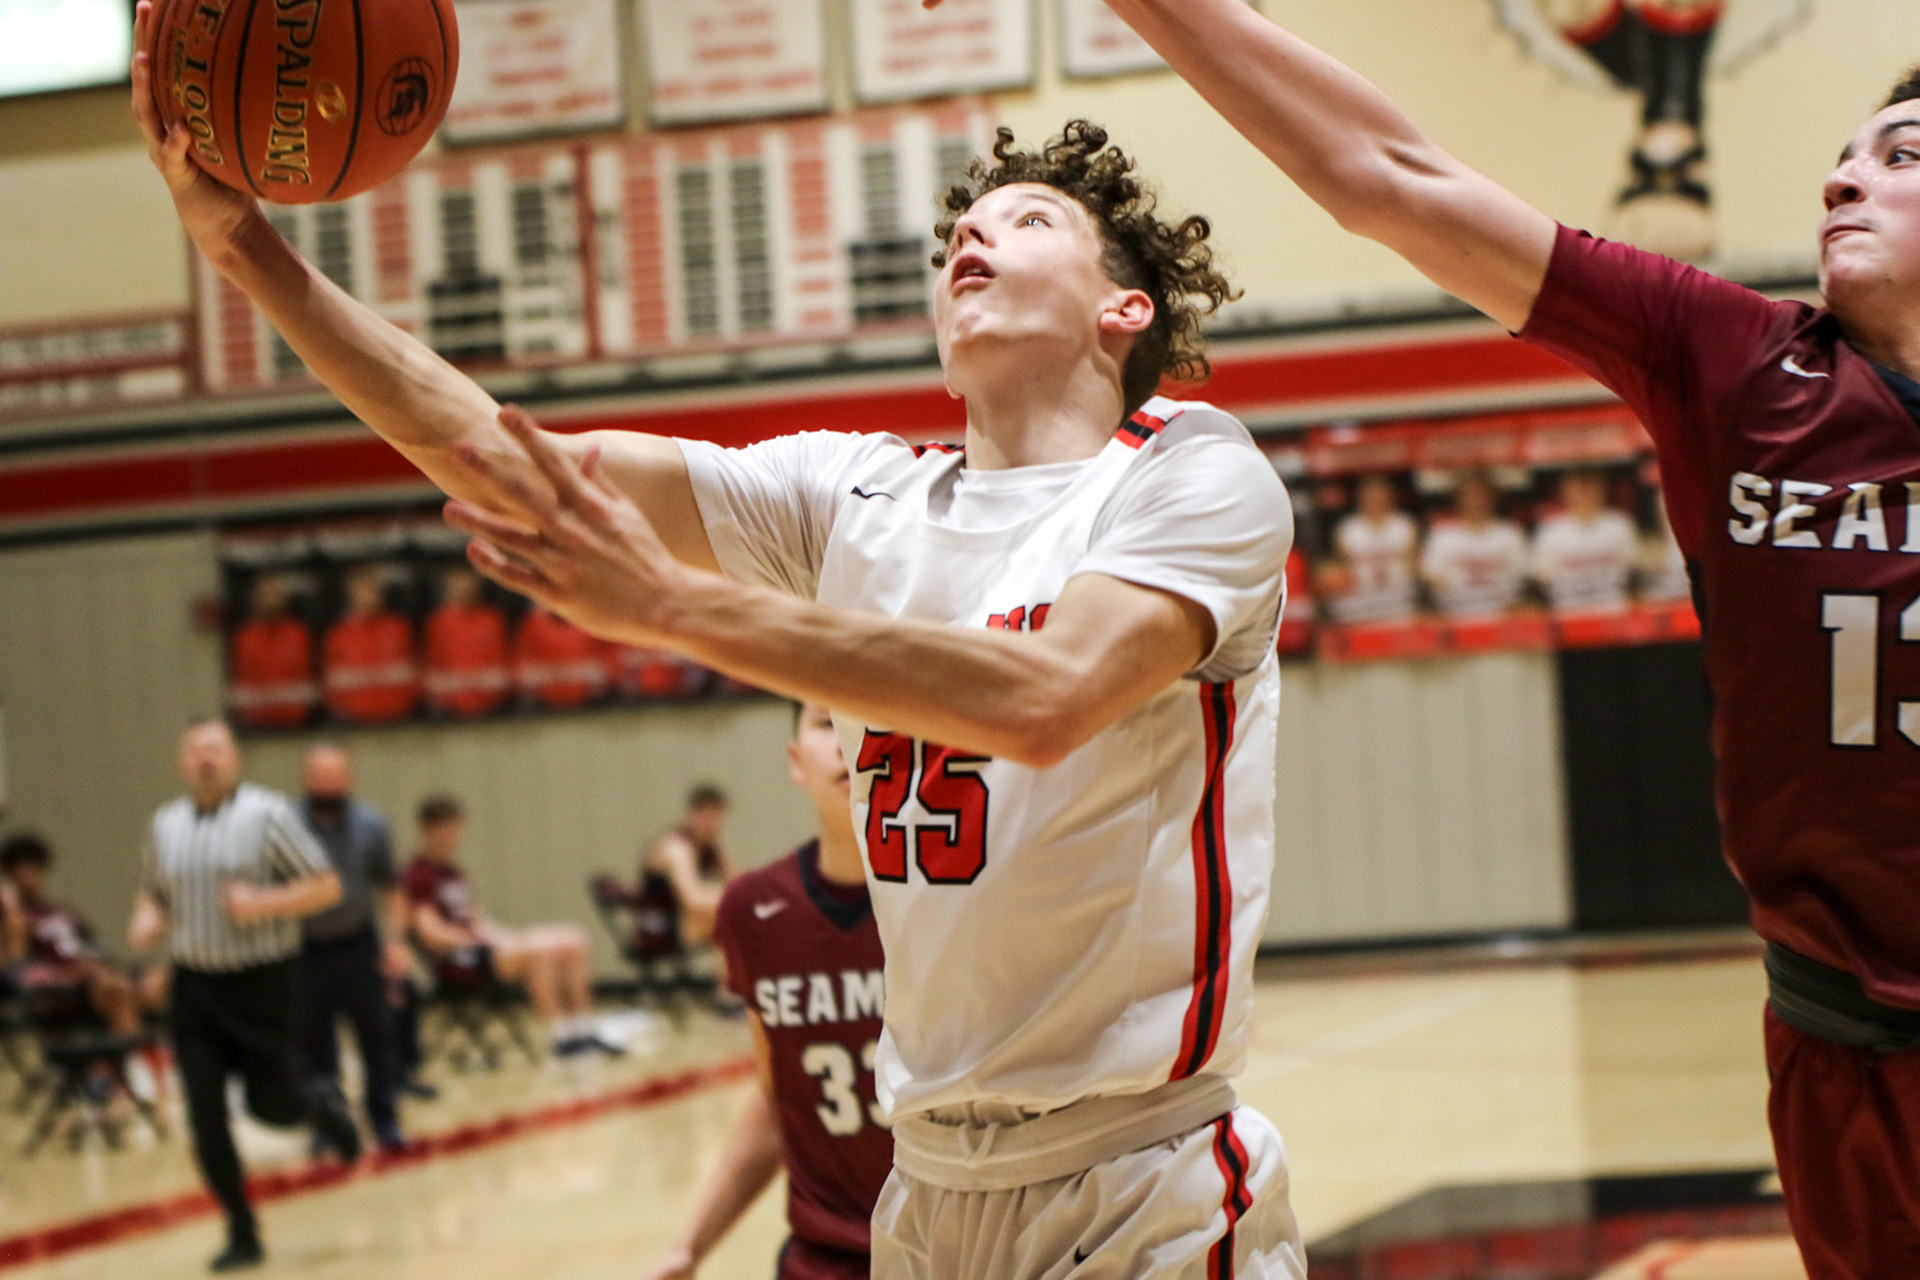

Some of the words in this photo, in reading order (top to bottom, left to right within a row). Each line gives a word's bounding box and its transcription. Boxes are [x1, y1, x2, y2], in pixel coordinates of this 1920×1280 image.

[263, 0, 322, 185] SPALDING
[856, 727, 992, 885] 25
[755, 969, 884, 1028] SEAM
